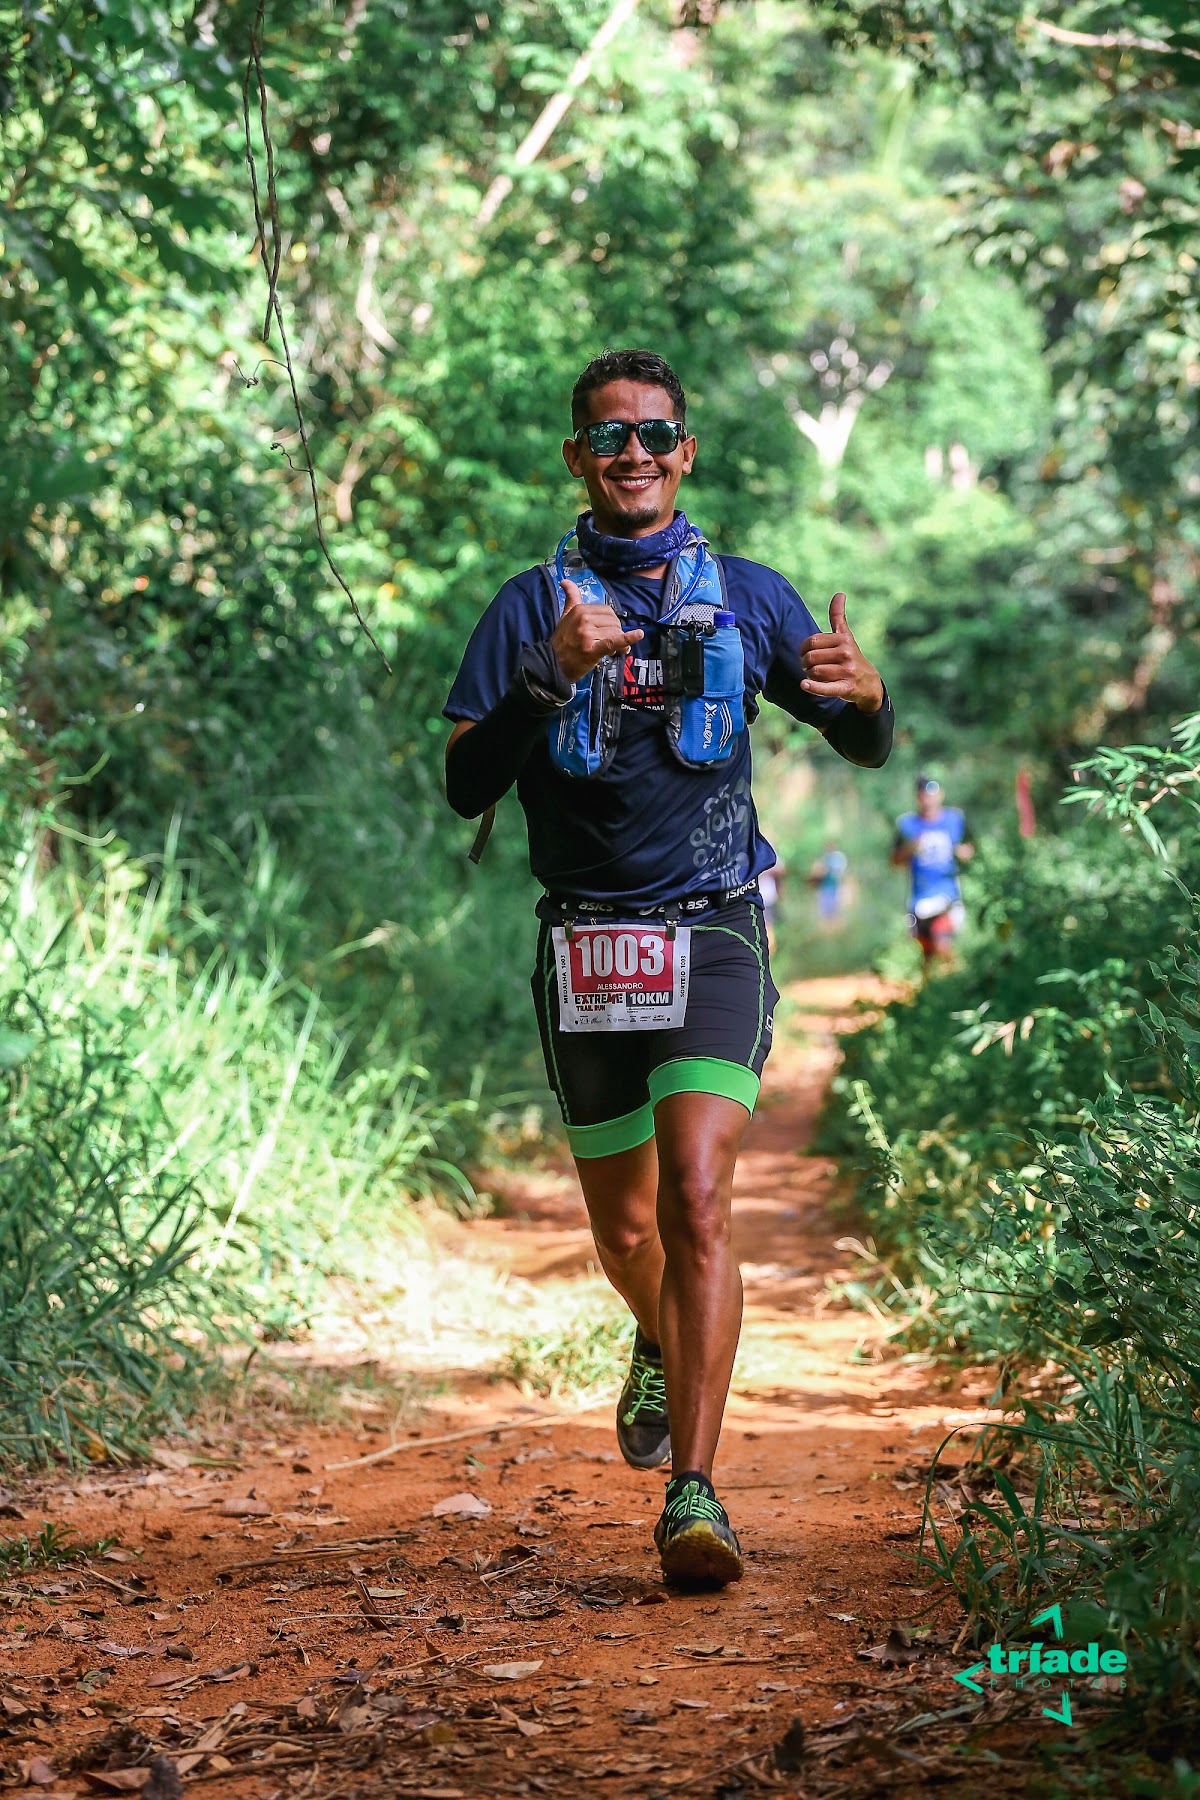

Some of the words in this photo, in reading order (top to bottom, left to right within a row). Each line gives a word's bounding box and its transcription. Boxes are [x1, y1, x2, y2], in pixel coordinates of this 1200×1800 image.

[578, 901, 614, 912] asics
[575, 933, 665, 977] 1003
[561, 971, 569, 1004] MEDALHA
[596, 982, 644, 991] ALESSANDRO
[574, 992, 623, 1005] EXTREME
[629, 992, 669, 1005] 10KM
[575, 1004, 594, 1012] TRAIL
[594, 1004, 606, 1012] RUN
